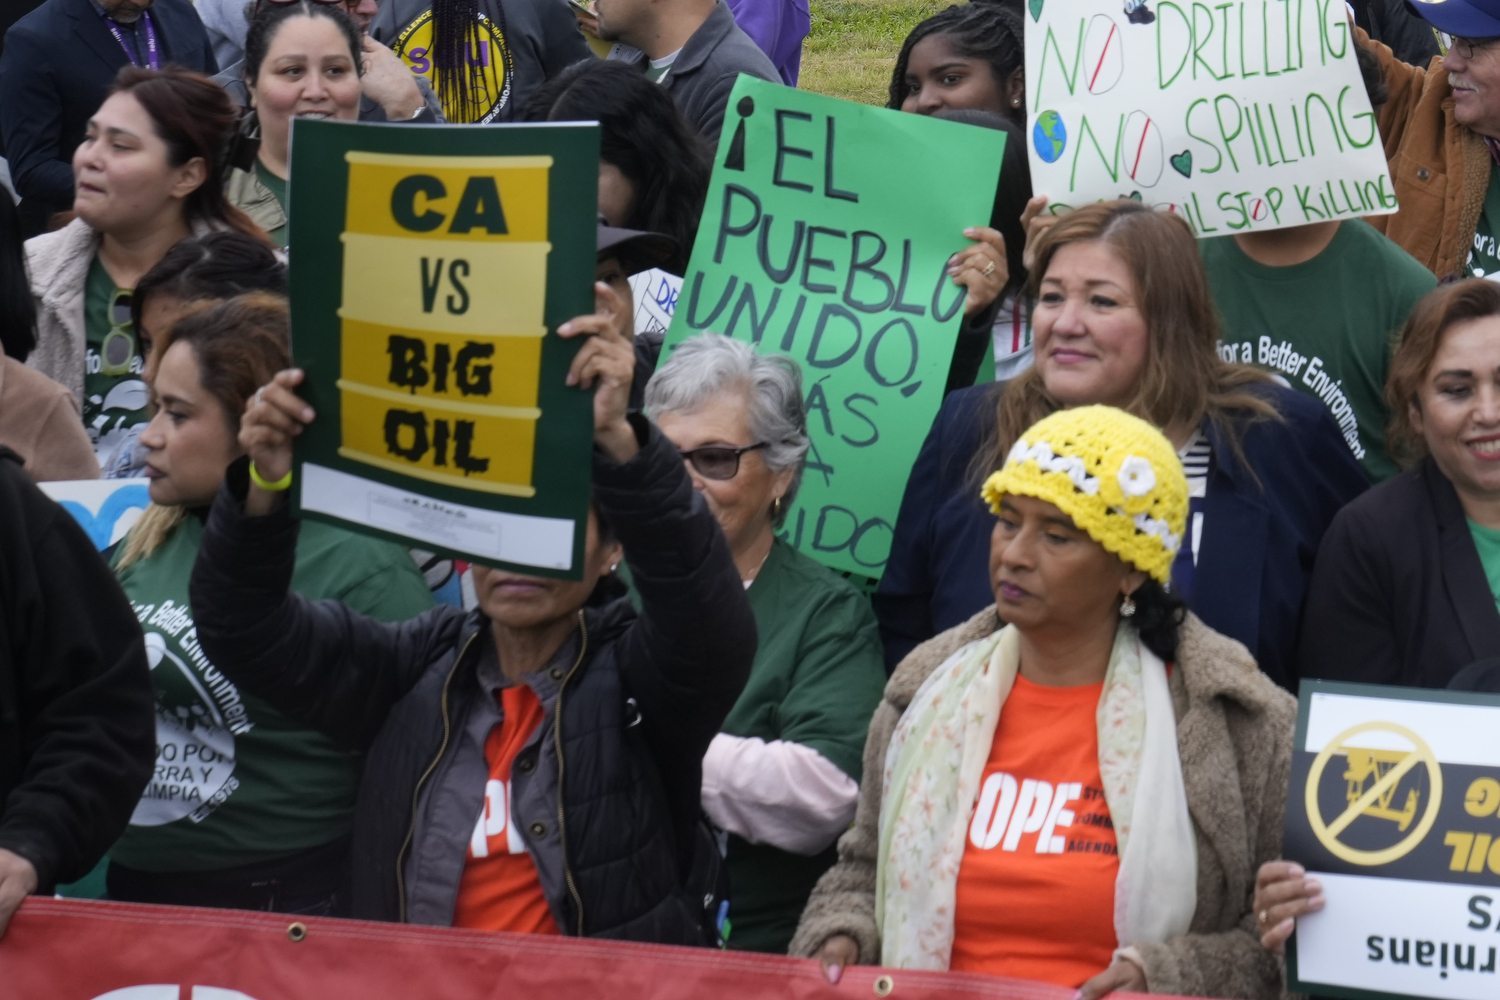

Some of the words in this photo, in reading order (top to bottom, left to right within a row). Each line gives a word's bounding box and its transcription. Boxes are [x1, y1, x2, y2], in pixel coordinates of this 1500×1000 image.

[1035, 13, 1124, 113] NO
[1070, 109, 1165, 193] NO
[390, 172, 509, 236] CA
[1217, 187, 1283, 229] STOP
[420, 256, 471, 316] VS
[713, 182, 969, 323] PUEBLO
[386, 333, 496, 398] BIG
[1241, 341, 1253, 365] a
[1257, 335, 1308, 377] Better
[1301, 355, 1366, 461] Environment
[383, 408, 490, 478] OIL
[149, 599, 194, 638] Better
[198, 766, 214, 785] Y
[968, 771, 1083, 854] OPE
